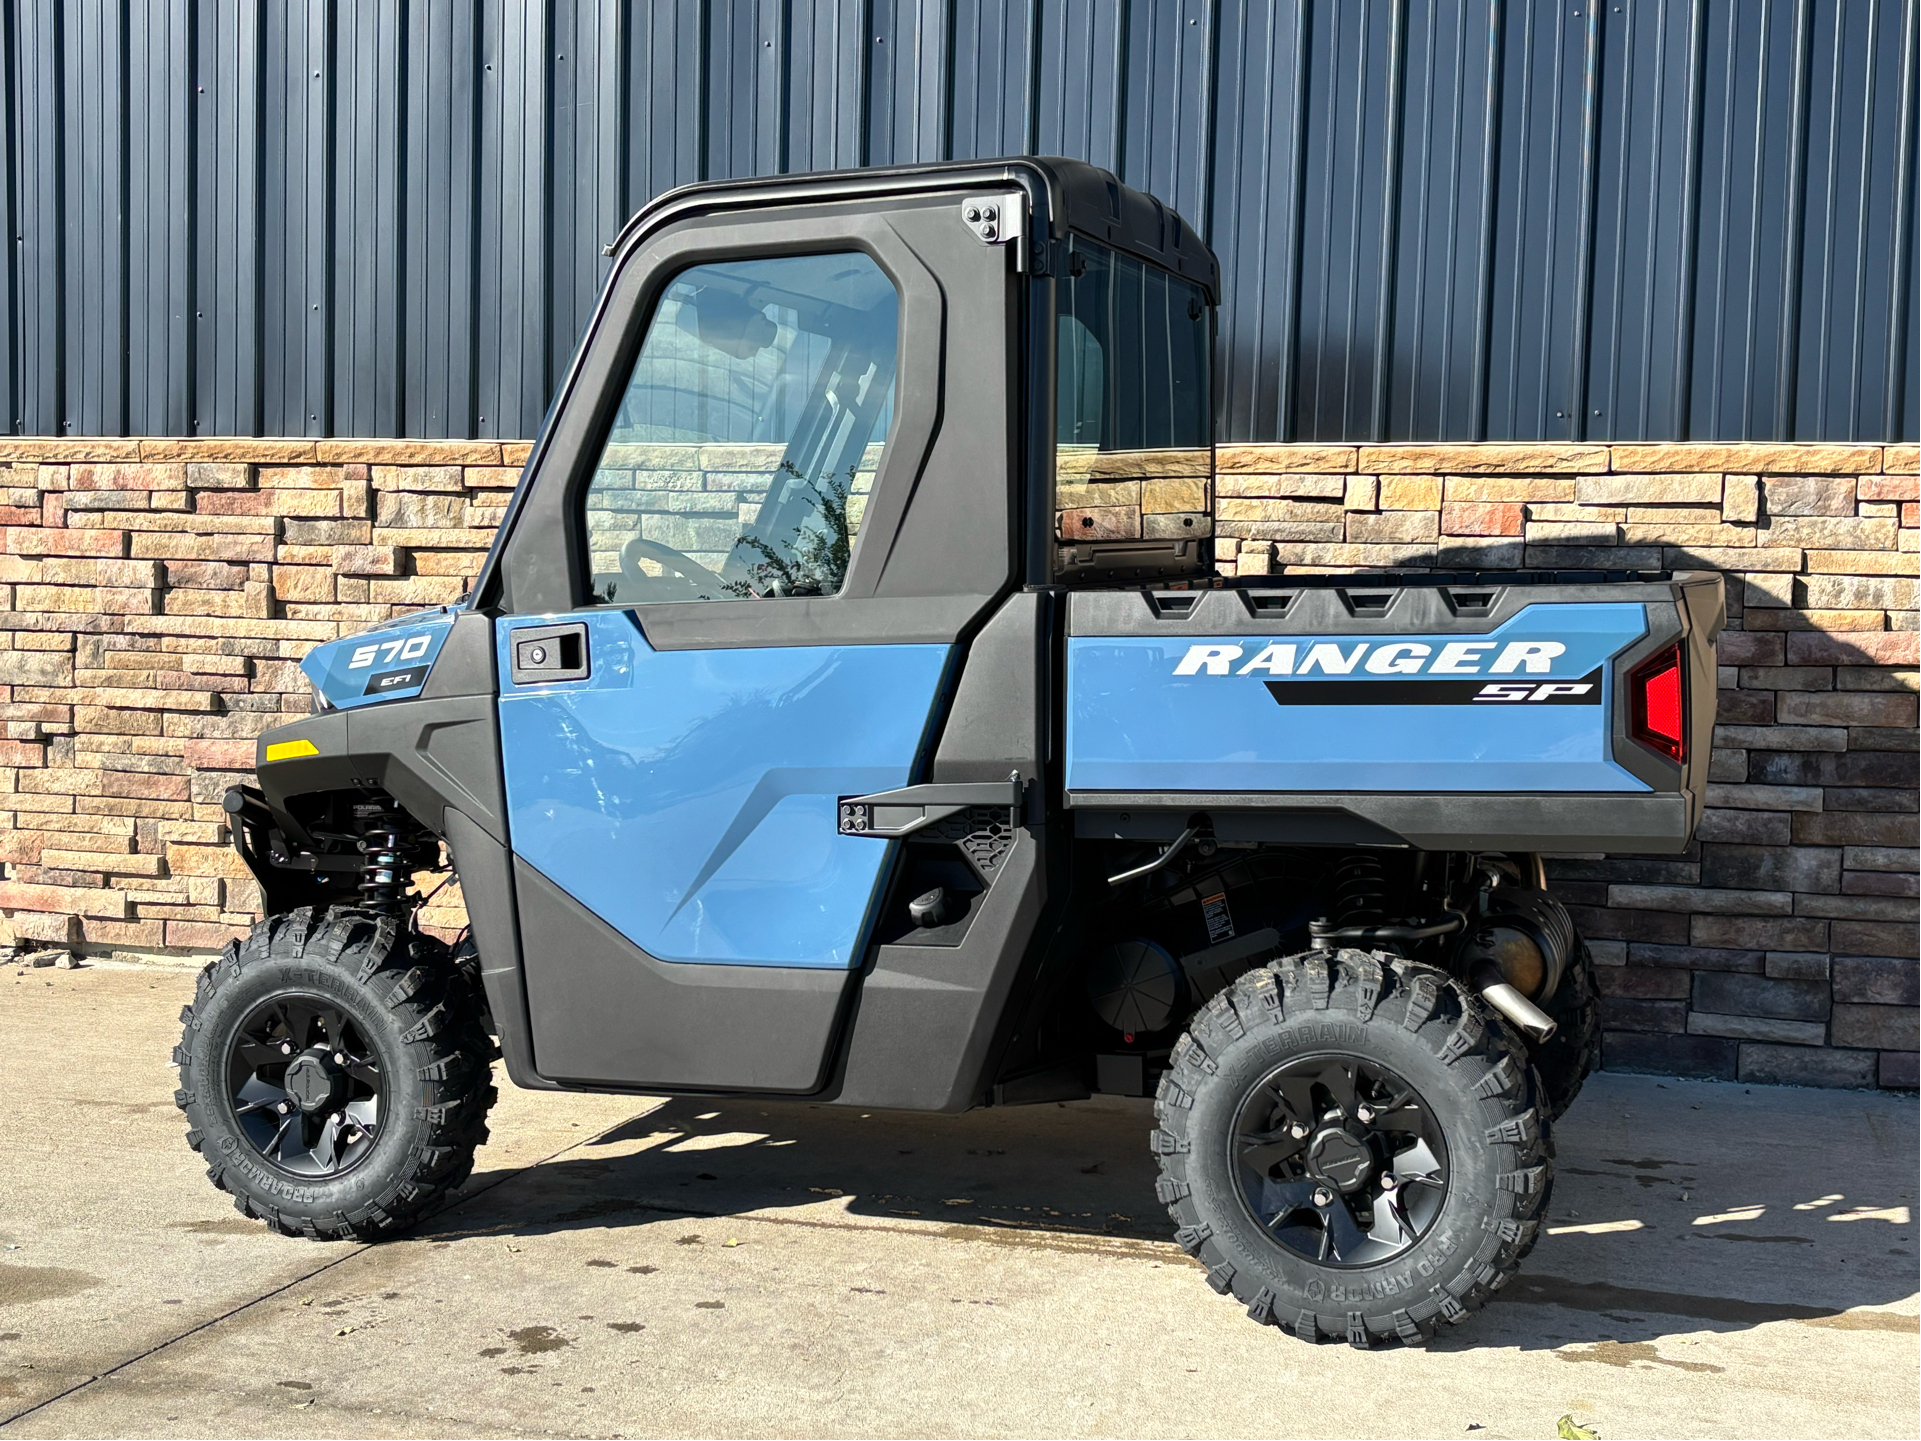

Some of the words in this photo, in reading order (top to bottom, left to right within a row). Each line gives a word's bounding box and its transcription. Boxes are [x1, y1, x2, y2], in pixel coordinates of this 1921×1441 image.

[350, 636, 432, 669] 570
[1172, 641, 1566, 676] RANGER
[381, 675, 411, 687] EFI
[1473, 683, 1594, 702] SP
[278, 967, 388, 1034] X-TERRAIN
[1222, 1023, 1367, 1089] X-TERRAIN
